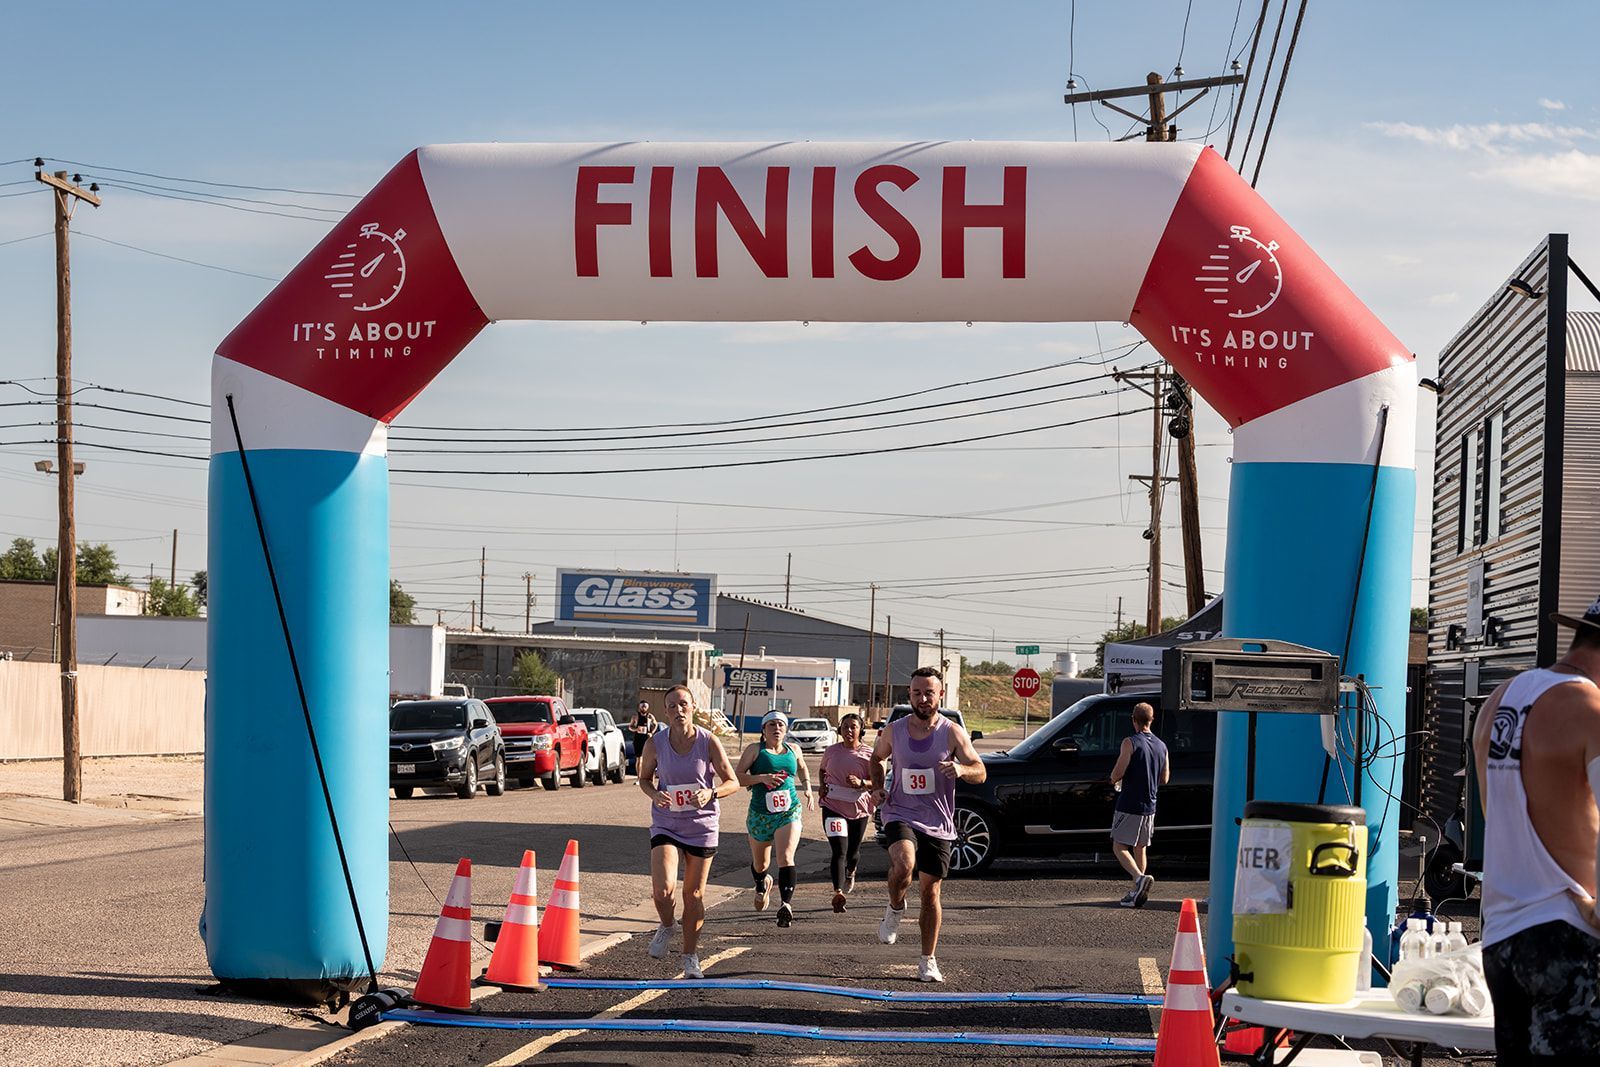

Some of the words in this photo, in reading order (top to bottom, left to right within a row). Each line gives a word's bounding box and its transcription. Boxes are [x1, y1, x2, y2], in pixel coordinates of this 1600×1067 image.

[575, 164, 1028, 281] FINISH
[293, 322, 336, 342] IT'S
[348, 320, 437, 341] ABOUT
[1171, 325, 1212, 347] IT'S
[1223, 330, 1314, 350] ABOUT
[316, 346, 412, 360] TIMING
[1195, 352, 1288, 369] TIMING
[623, 578, 695, 589] Binswanger
[574, 577, 698, 609] Glass
[1110, 657, 1145, 665] GENERAL
[729, 669, 768, 682] Glass
[1014, 677, 1039, 689] STOP
[909, 774, 926, 790] 39
[675, 789, 692, 806] 63
[772, 795, 786, 808] 65
[830, 821, 842, 833] 66
